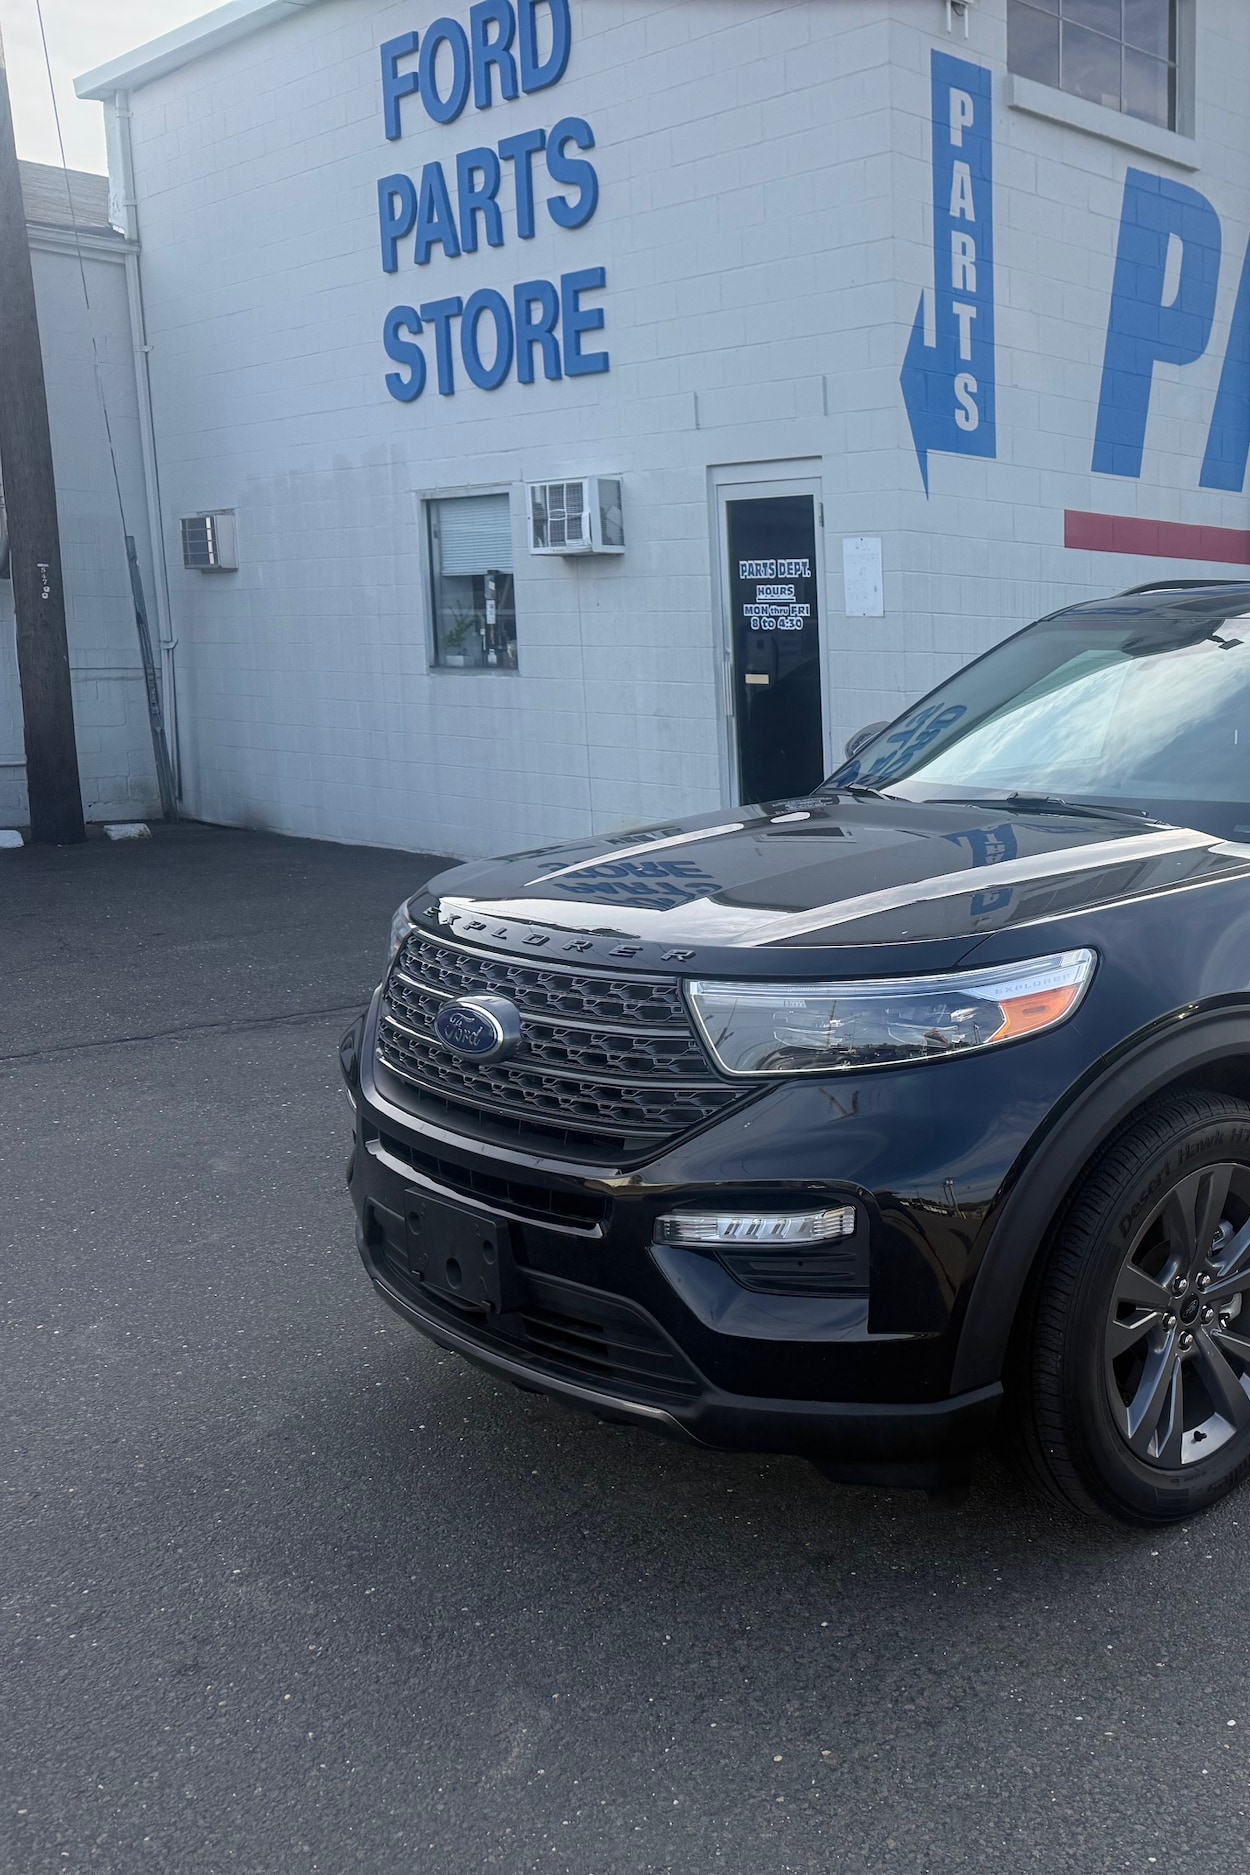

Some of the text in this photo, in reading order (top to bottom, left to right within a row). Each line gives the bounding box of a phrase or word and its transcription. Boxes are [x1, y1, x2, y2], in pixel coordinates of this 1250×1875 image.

[379, 0, 571, 141] FORD
[377, 116, 600, 274] PARTS
[948, 86, 980, 432] PARTS
[384, 266, 610, 403] STORE
[739, 559, 811, 579] PARTS DEPT.
[756, 585, 795, 598] HOURS
[743, 603, 811, 617] MON thru FRI
[751, 617, 803, 631] 8 to 4:30
[422, 906, 697, 963] EXPLORER
[995, 973, 1071, 995] EXPLORER
[444, 1012, 484, 1047] Ford
[1118, 1161, 1170, 1239] Desert
[1177, 1130, 1225, 1166] Hawk
